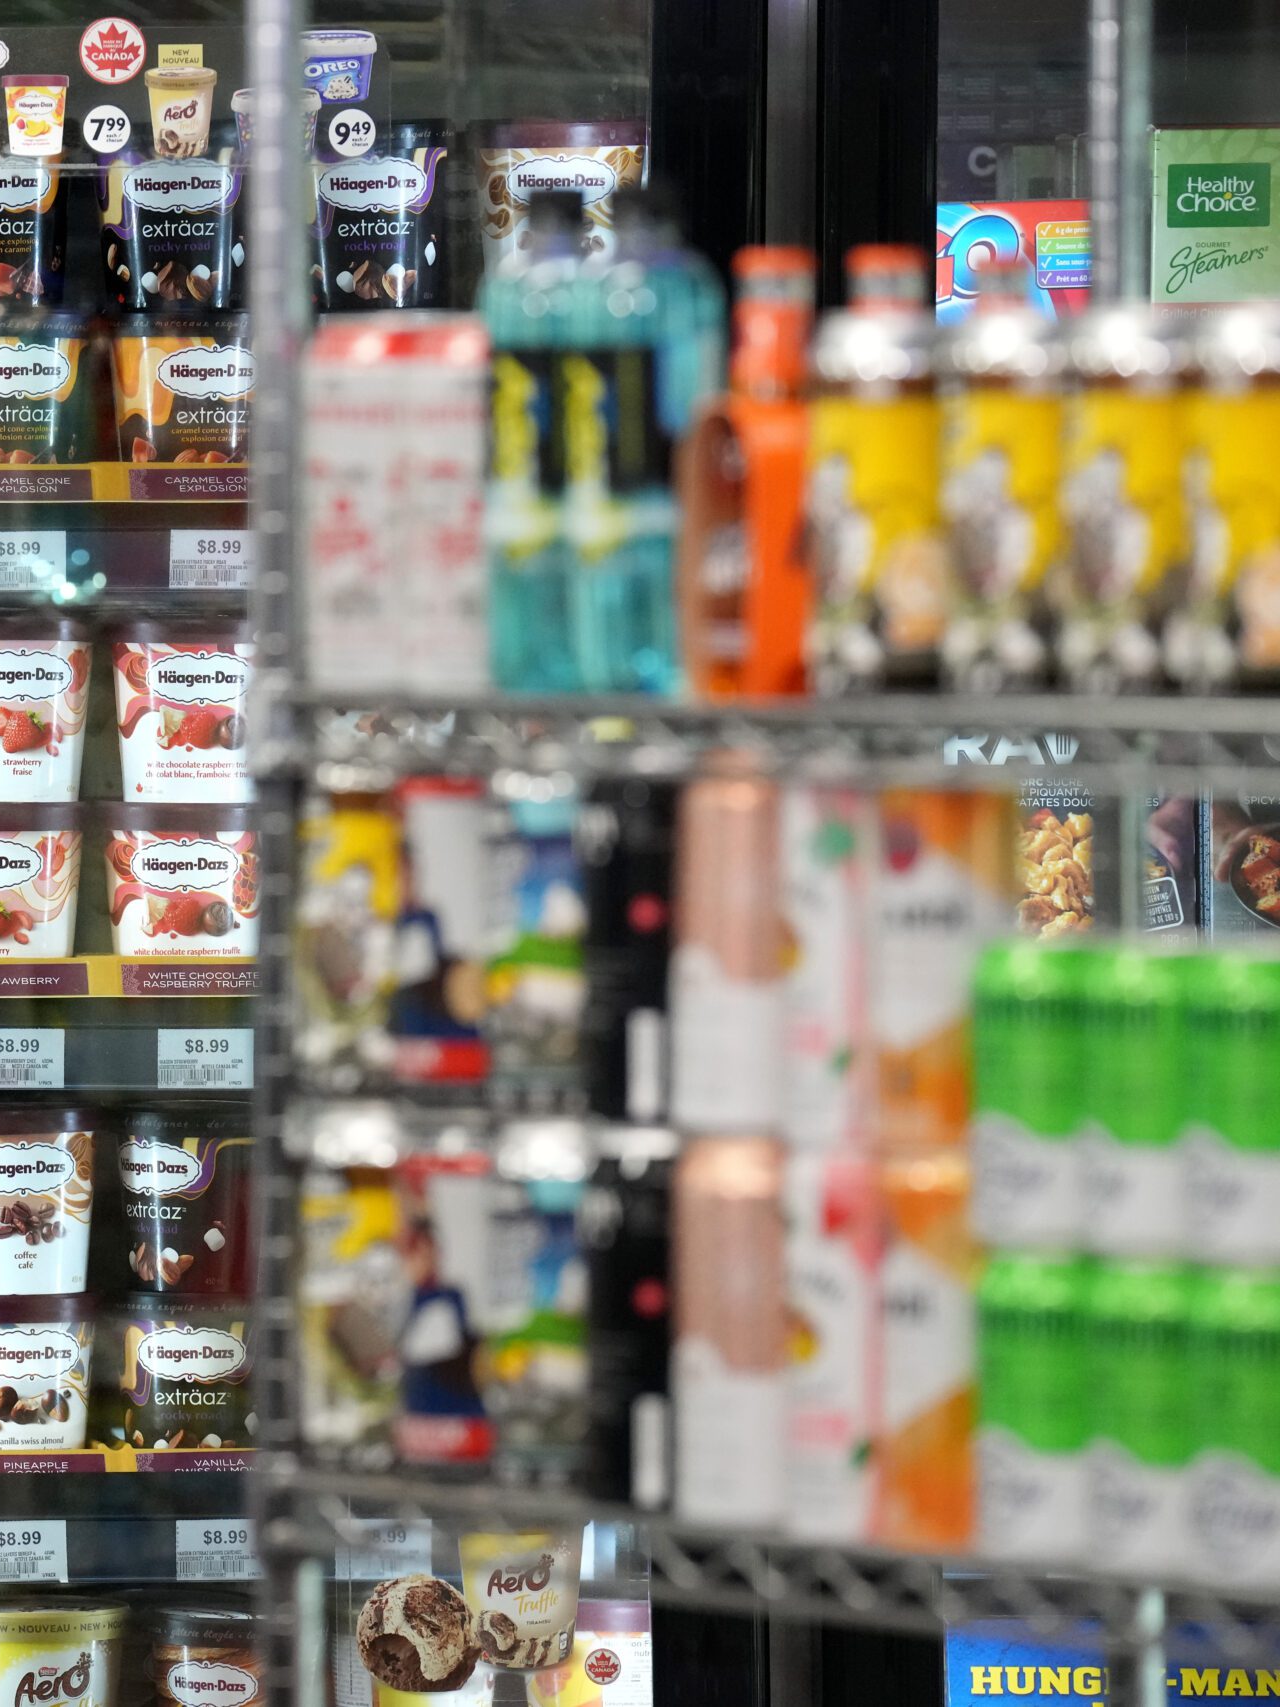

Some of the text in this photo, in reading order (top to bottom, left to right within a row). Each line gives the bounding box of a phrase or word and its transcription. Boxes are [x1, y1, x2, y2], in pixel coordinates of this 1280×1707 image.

[91, 52, 135, 60] CANADA
[304, 60, 360, 77] OREO
[134, 176, 221, 194] Häagen-Dazs
[517, 174, 606, 191] Häagen-Dazs
[1188, 176, 1255, 202] Healthy
[1177, 192, 1257, 213] Choice
[142, 220, 216, 238] exträaz
[338, 219, 410, 237] exträaz
[0, 246, 32, 255] caramel
[1166, 246, 1265, 294] Steamers
[176, 407, 246, 424] exträaz
[181, 435, 211, 444] explosion
[37, 477, 71, 485] CONE
[165, 476, 251, 485] CARAMEL CON
[179, 484, 247, 493] EXPLOSION
[197, 539, 241, 555] $8.99
[158, 671, 244, 687] Häagen-Dazs
[3, 758, 42, 768] strawberry
[166, 761, 200, 769] chocolate
[12, 767, 33, 776] fraise
[174, 770, 195, 779] blanc,
[1030, 788, 1079, 797] PIQUANT
[142, 858, 228, 875] Häagen-Dazs
[134, 946, 240, 956] white chocolate raspberry truffle
[148, 972, 260, 980] WHITE CHOCOLATE
[143, 980, 213, 988] RASPBERRY
[185, 1039, 229, 1054] $8.99
[126, 1202, 183, 1220] exträaz
[14, 1251, 38, 1260] coffee
[18, 1259, 34, 1269] café
[154, 1388, 227, 1406] exträaz
[21, 1437, 39, 1445] swiss
[40, 1436, 64, 1445] almond
[3, 1461, 69, 1470] PINEAPPLE
[194, 1458, 245, 1467] VANILLA
[203, 1529, 247, 1546] $8.99
[487, 1553, 555, 1597] Aero
[514, 1589, 560, 1616] Truffle
[19, 1624, 71, 1633] NOUVEAU
[80, 1623, 100, 1632] NEW
